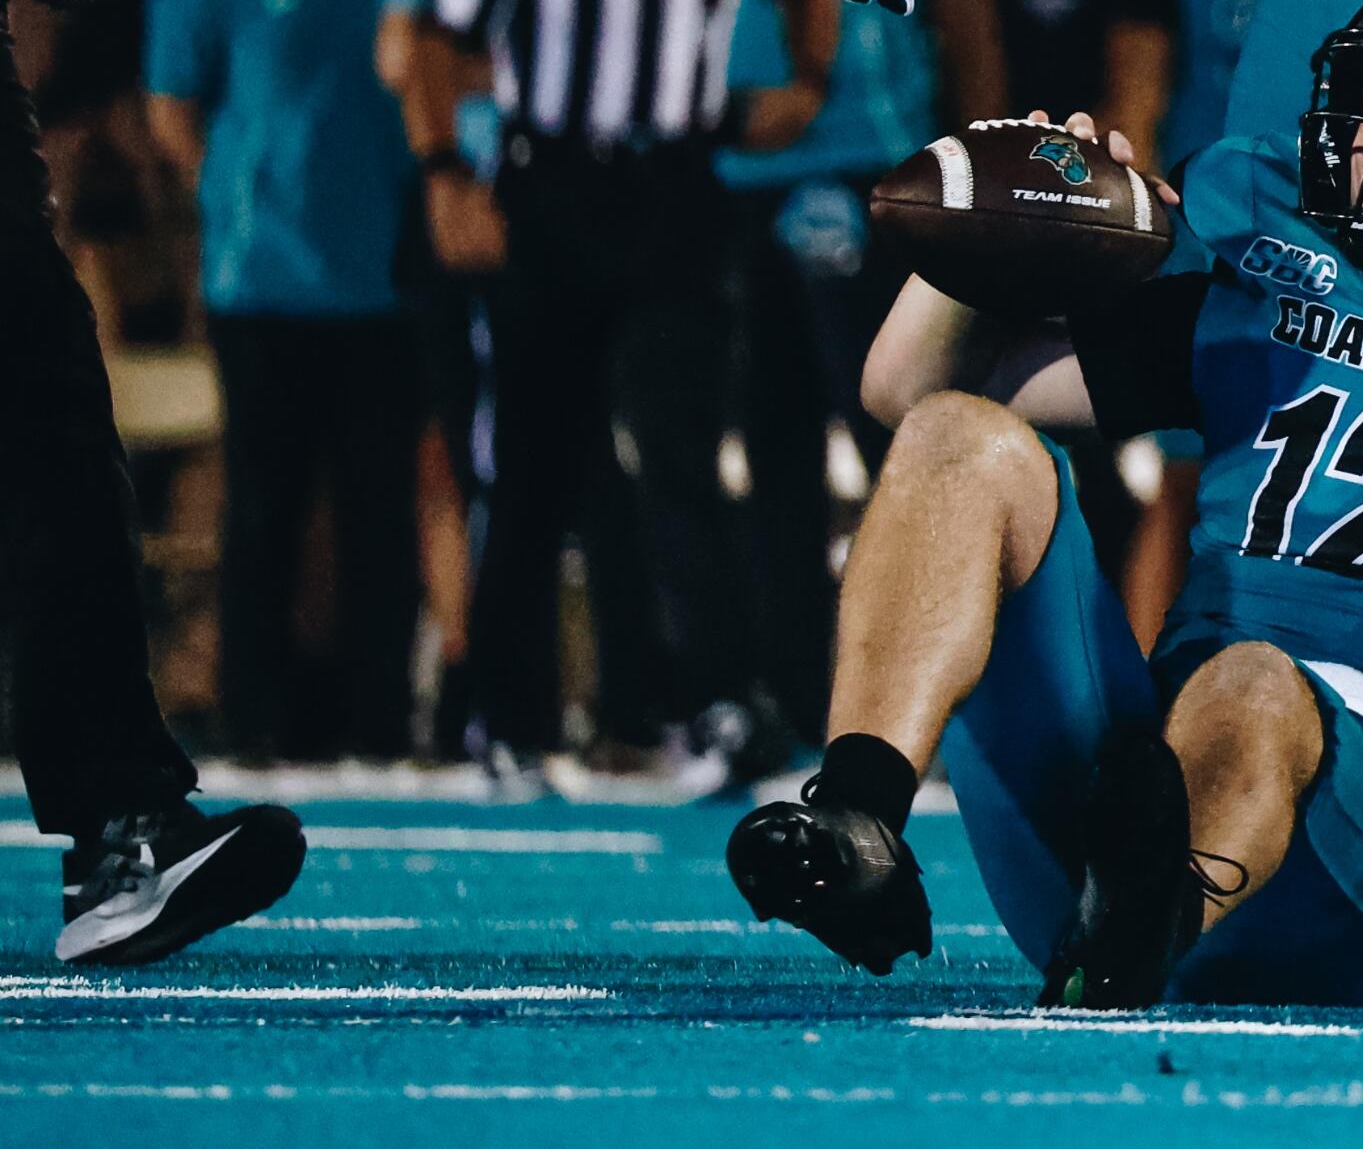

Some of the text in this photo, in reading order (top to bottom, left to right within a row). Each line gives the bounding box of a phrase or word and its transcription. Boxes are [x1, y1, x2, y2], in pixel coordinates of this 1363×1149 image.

[1012, 189, 1112, 209] TEAM ISSUE
[1240, 235, 1338, 296] SBC
